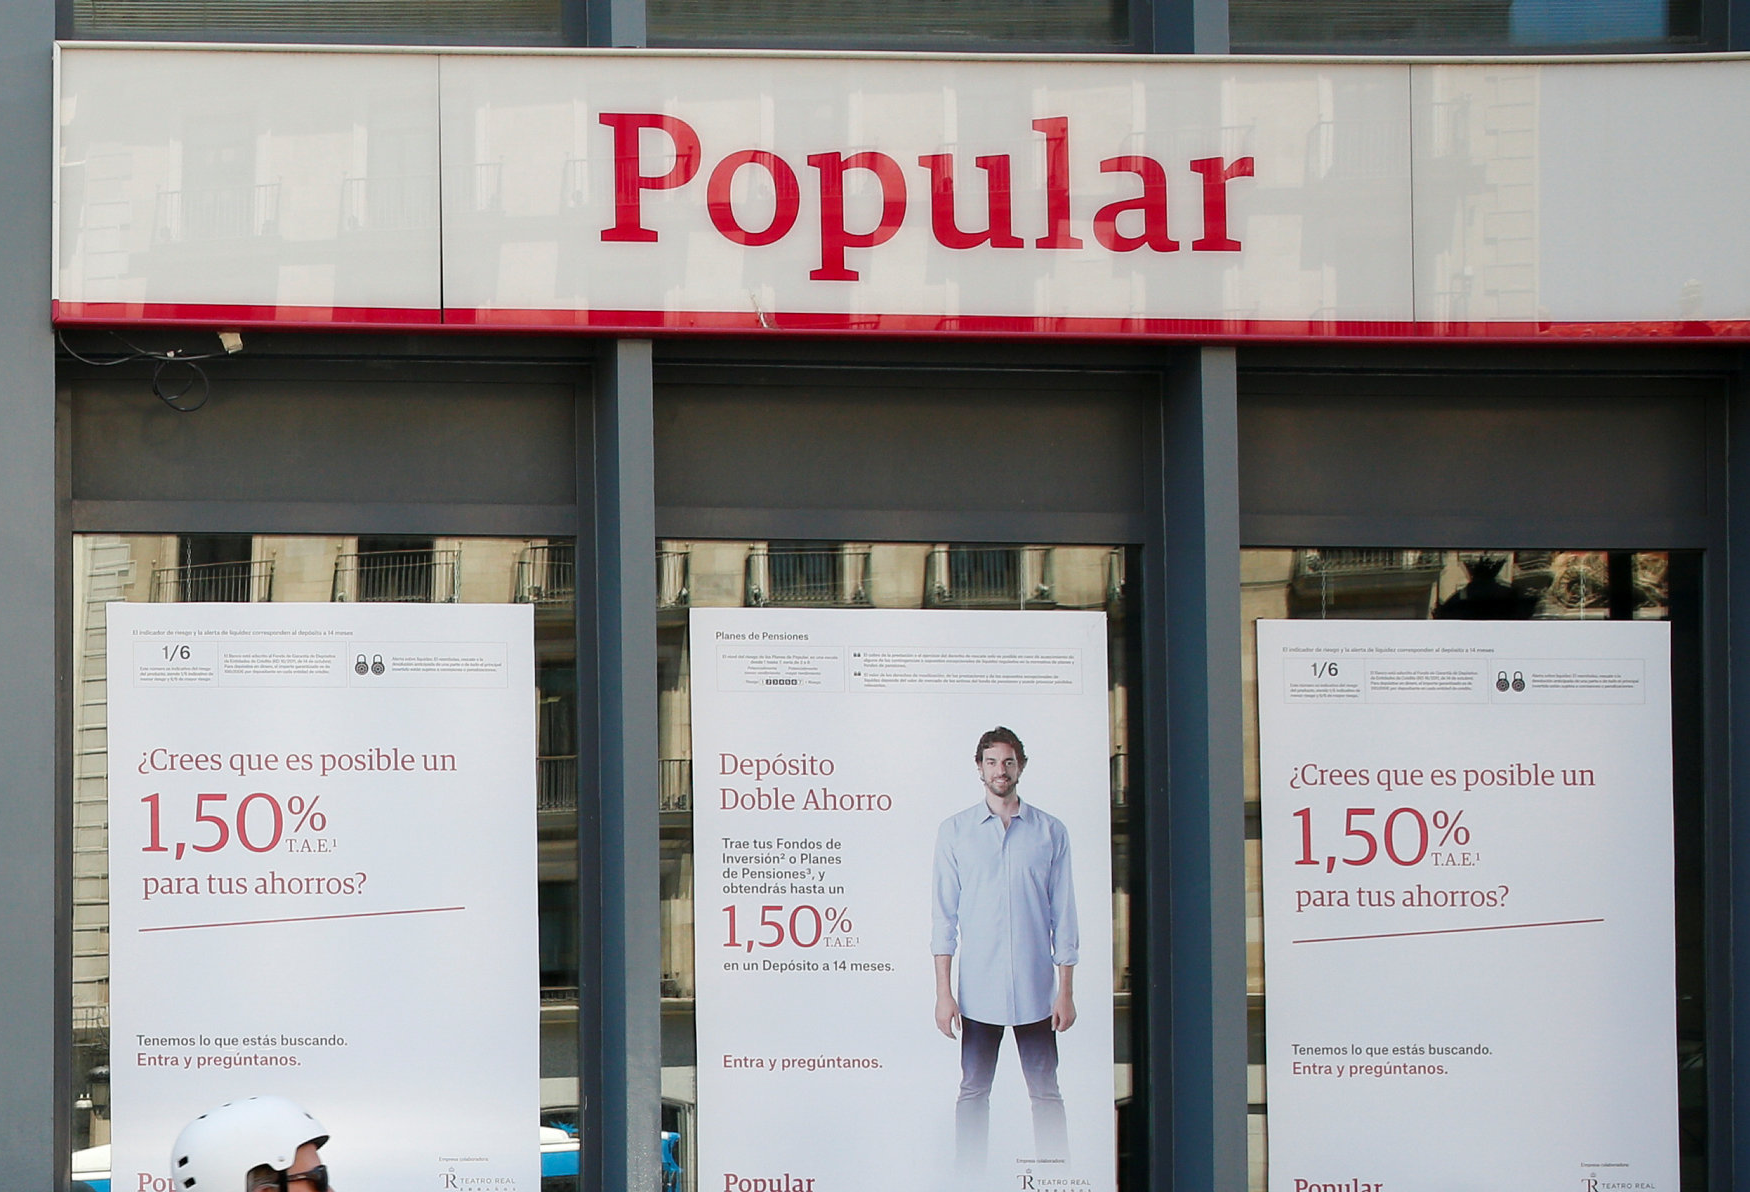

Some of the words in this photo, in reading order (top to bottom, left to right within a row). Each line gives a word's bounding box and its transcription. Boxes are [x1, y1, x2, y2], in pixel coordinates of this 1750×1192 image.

[598, 112, 1255, 282] Popular
[715, 631, 747, 641] Planes
[748, 631, 760, 641] de
[762, 631, 809, 641] Pensiones
[162, 644, 191, 662] 1/6
[1311, 661, 1339, 679] 1/6
[137, 748, 223, 775] ¿Crees
[229, 753, 279, 777] que
[285, 753, 313, 771] es
[320, 747, 416, 777] posible
[421, 754, 457, 772] un
[719, 753, 835, 781] Depósito
[1289, 763, 1370, 790] ¿Crees
[1376, 769, 1424, 792] que
[1430, 769, 1457, 786] es
[1463, 762, 1555, 792] posible
[1561, 769, 1596, 786] un
[719, 786, 796, 811] Doble
[801, 787, 892, 812] Ahorro
[140, 792, 328, 861] 1,50%
[721, 837, 750, 850] Trae
[752, 839, 773, 850] tus
[776, 837, 823, 850] Fondos
[825, 838, 842, 850] de
[1292, 807, 1471, 874] 1,50%
[788, 855, 797, 865] o
[800, 852, 842, 865] Planes
[722, 867, 738, 879] de
[817, 871, 826, 882] y
[142, 877, 200, 901] para
[206, 873, 248, 895] tus
[254, 870, 367, 895] ahorros?
[722, 882, 787, 895] obtendrás
[790, 882, 825, 895] hasta
[828, 886, 845, 895] un
[1295, 890, 1351, 913] para
[1356, 887, 1396, 908] tus
[1401, 884, 1509, 908] ahorros?
[722, 904, 853, 953] 1,50%
[723, 962, 739, 971] en
[742, 962, 759, 971] un
[762, 959, 819, 974] Depósito
[822, 962, 830, 971] a
[833, 960, 847, 972] 14
[850, 962, 895, 972] meses.
[135, 1034, 196, 1047] Tenemos
[199, 1034, 211, 1047] lo
[214, 1037, 239, 1049] que
[242, 1034, 277, 1046] estás
[280, 1034, 348, 1046] buscando.
[1291, 1043, 1348, 1056] Tenemos
[1351, 1043, 1363, 1056] lo
[1365, 1046, 1389, 1058] que
[1391, 1043, 1426, 1056] estás
[1428, 1043, 1493, 1056] buscando.
[137, 1052, 180, 1067] Entra
[183, 1056, 193, 1070] y
[197, 1052, 301, 1070] pregúntanos.
[723, 1054, 765, 1069] Entra
[768, 1058, 777, 1072] y
[781, 1054, 883, 1072] pregúntanos.
[1292, 1061, 1333, 1075] Entra
[1336, 1065, 1345, 1078] y
[1349, 1061, 1448, 1078] pregúntanos.
[460, 1177, 492, 1185] TEATRO
[494, 1177, 516, 1185] REAL
[1036, 1178, 1068, 1186] TEATRO
[1070, 1178, 1092, 1186] REAL
[1601, 1182, 1633, 1190] TEATRO
[1634, 1182, 1656, 1190] REAL
